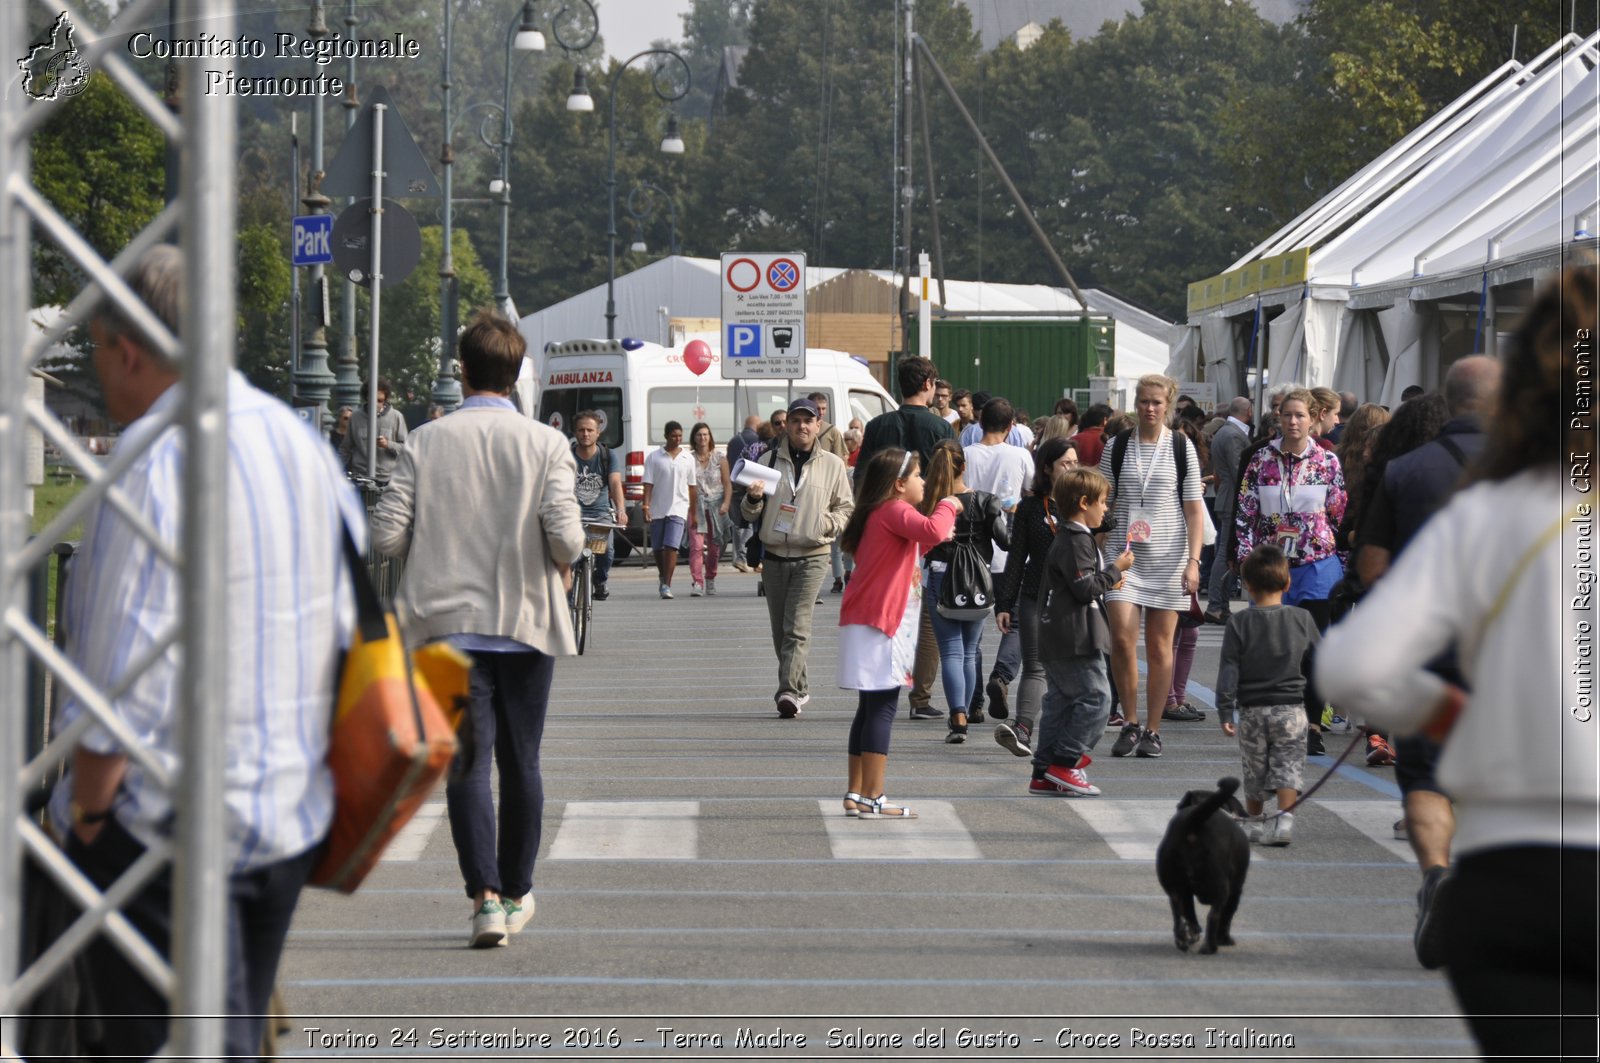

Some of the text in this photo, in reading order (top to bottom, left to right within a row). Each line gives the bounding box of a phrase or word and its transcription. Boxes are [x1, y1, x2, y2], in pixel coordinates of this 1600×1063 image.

[294, 223, 331, 256] Park
[733, 327, 754, 355] P
[549, 371, 613, 386] AMBULANZA
